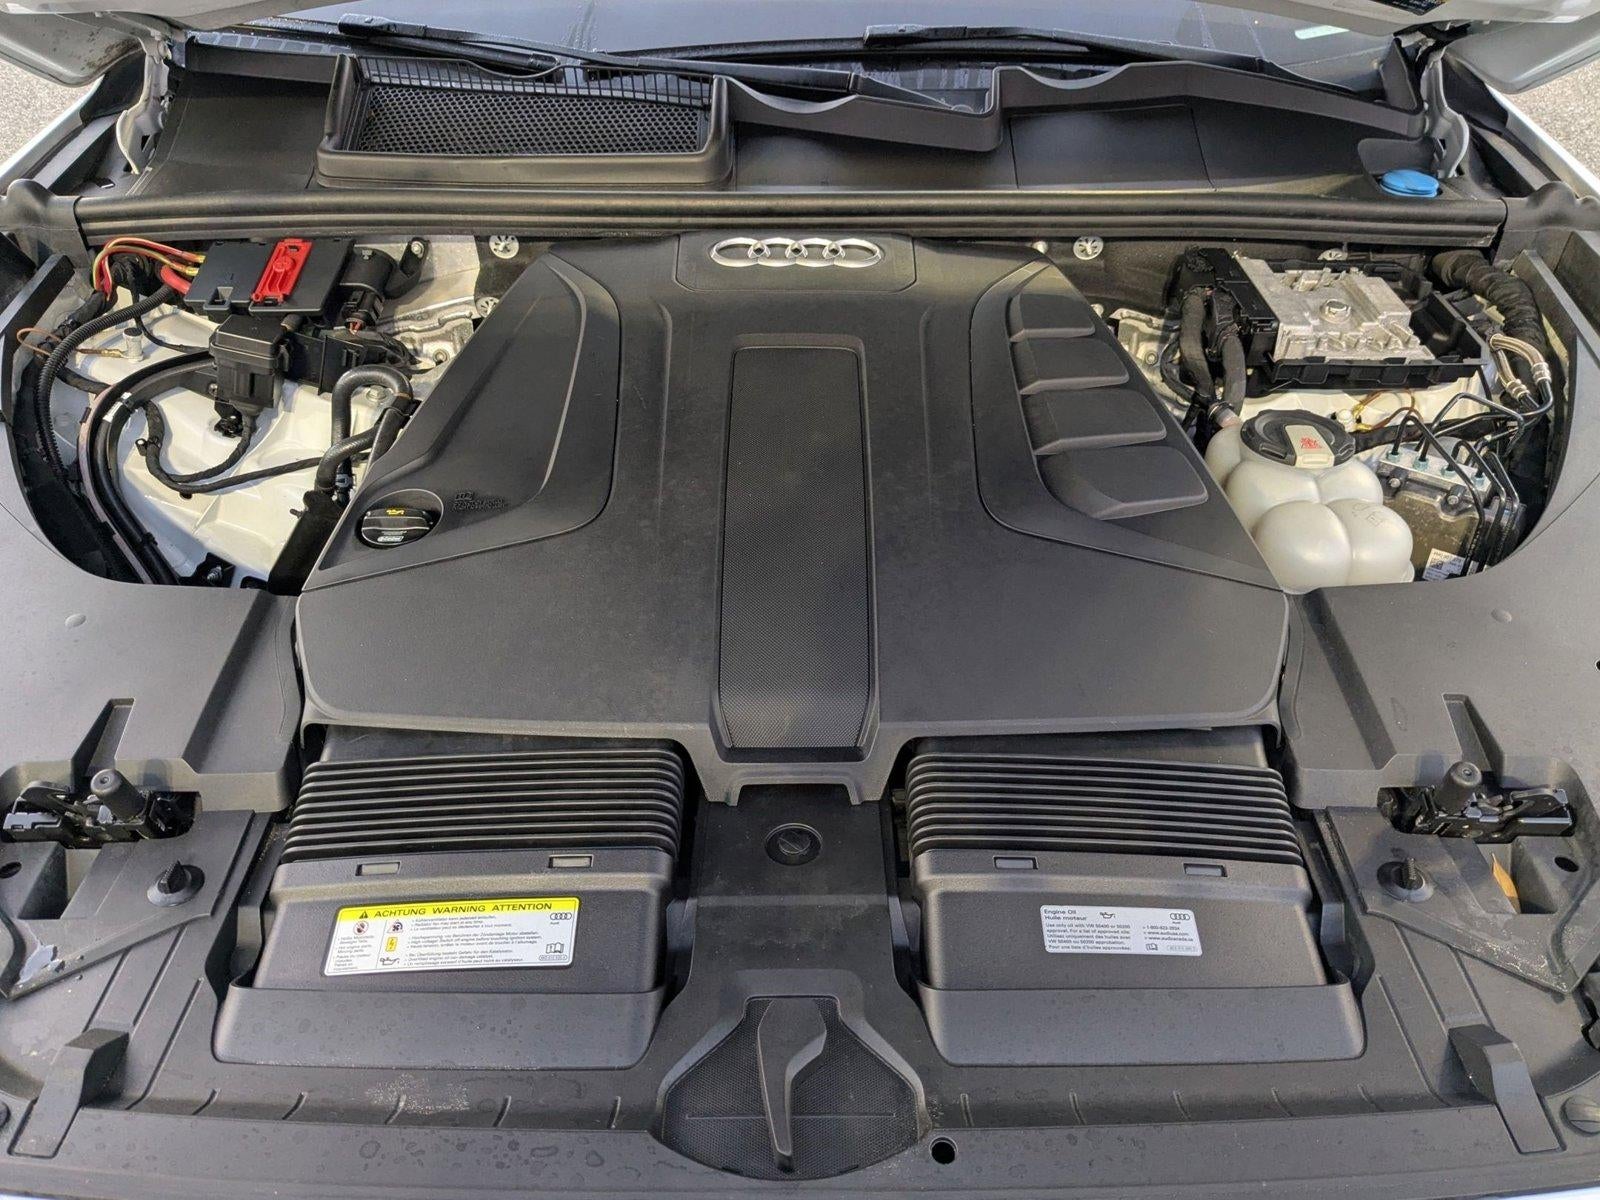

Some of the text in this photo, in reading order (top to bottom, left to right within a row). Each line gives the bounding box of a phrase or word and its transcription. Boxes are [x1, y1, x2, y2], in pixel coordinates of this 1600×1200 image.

[374, 903, 552, 918] ACHTUNG WARNING ATTENTION
